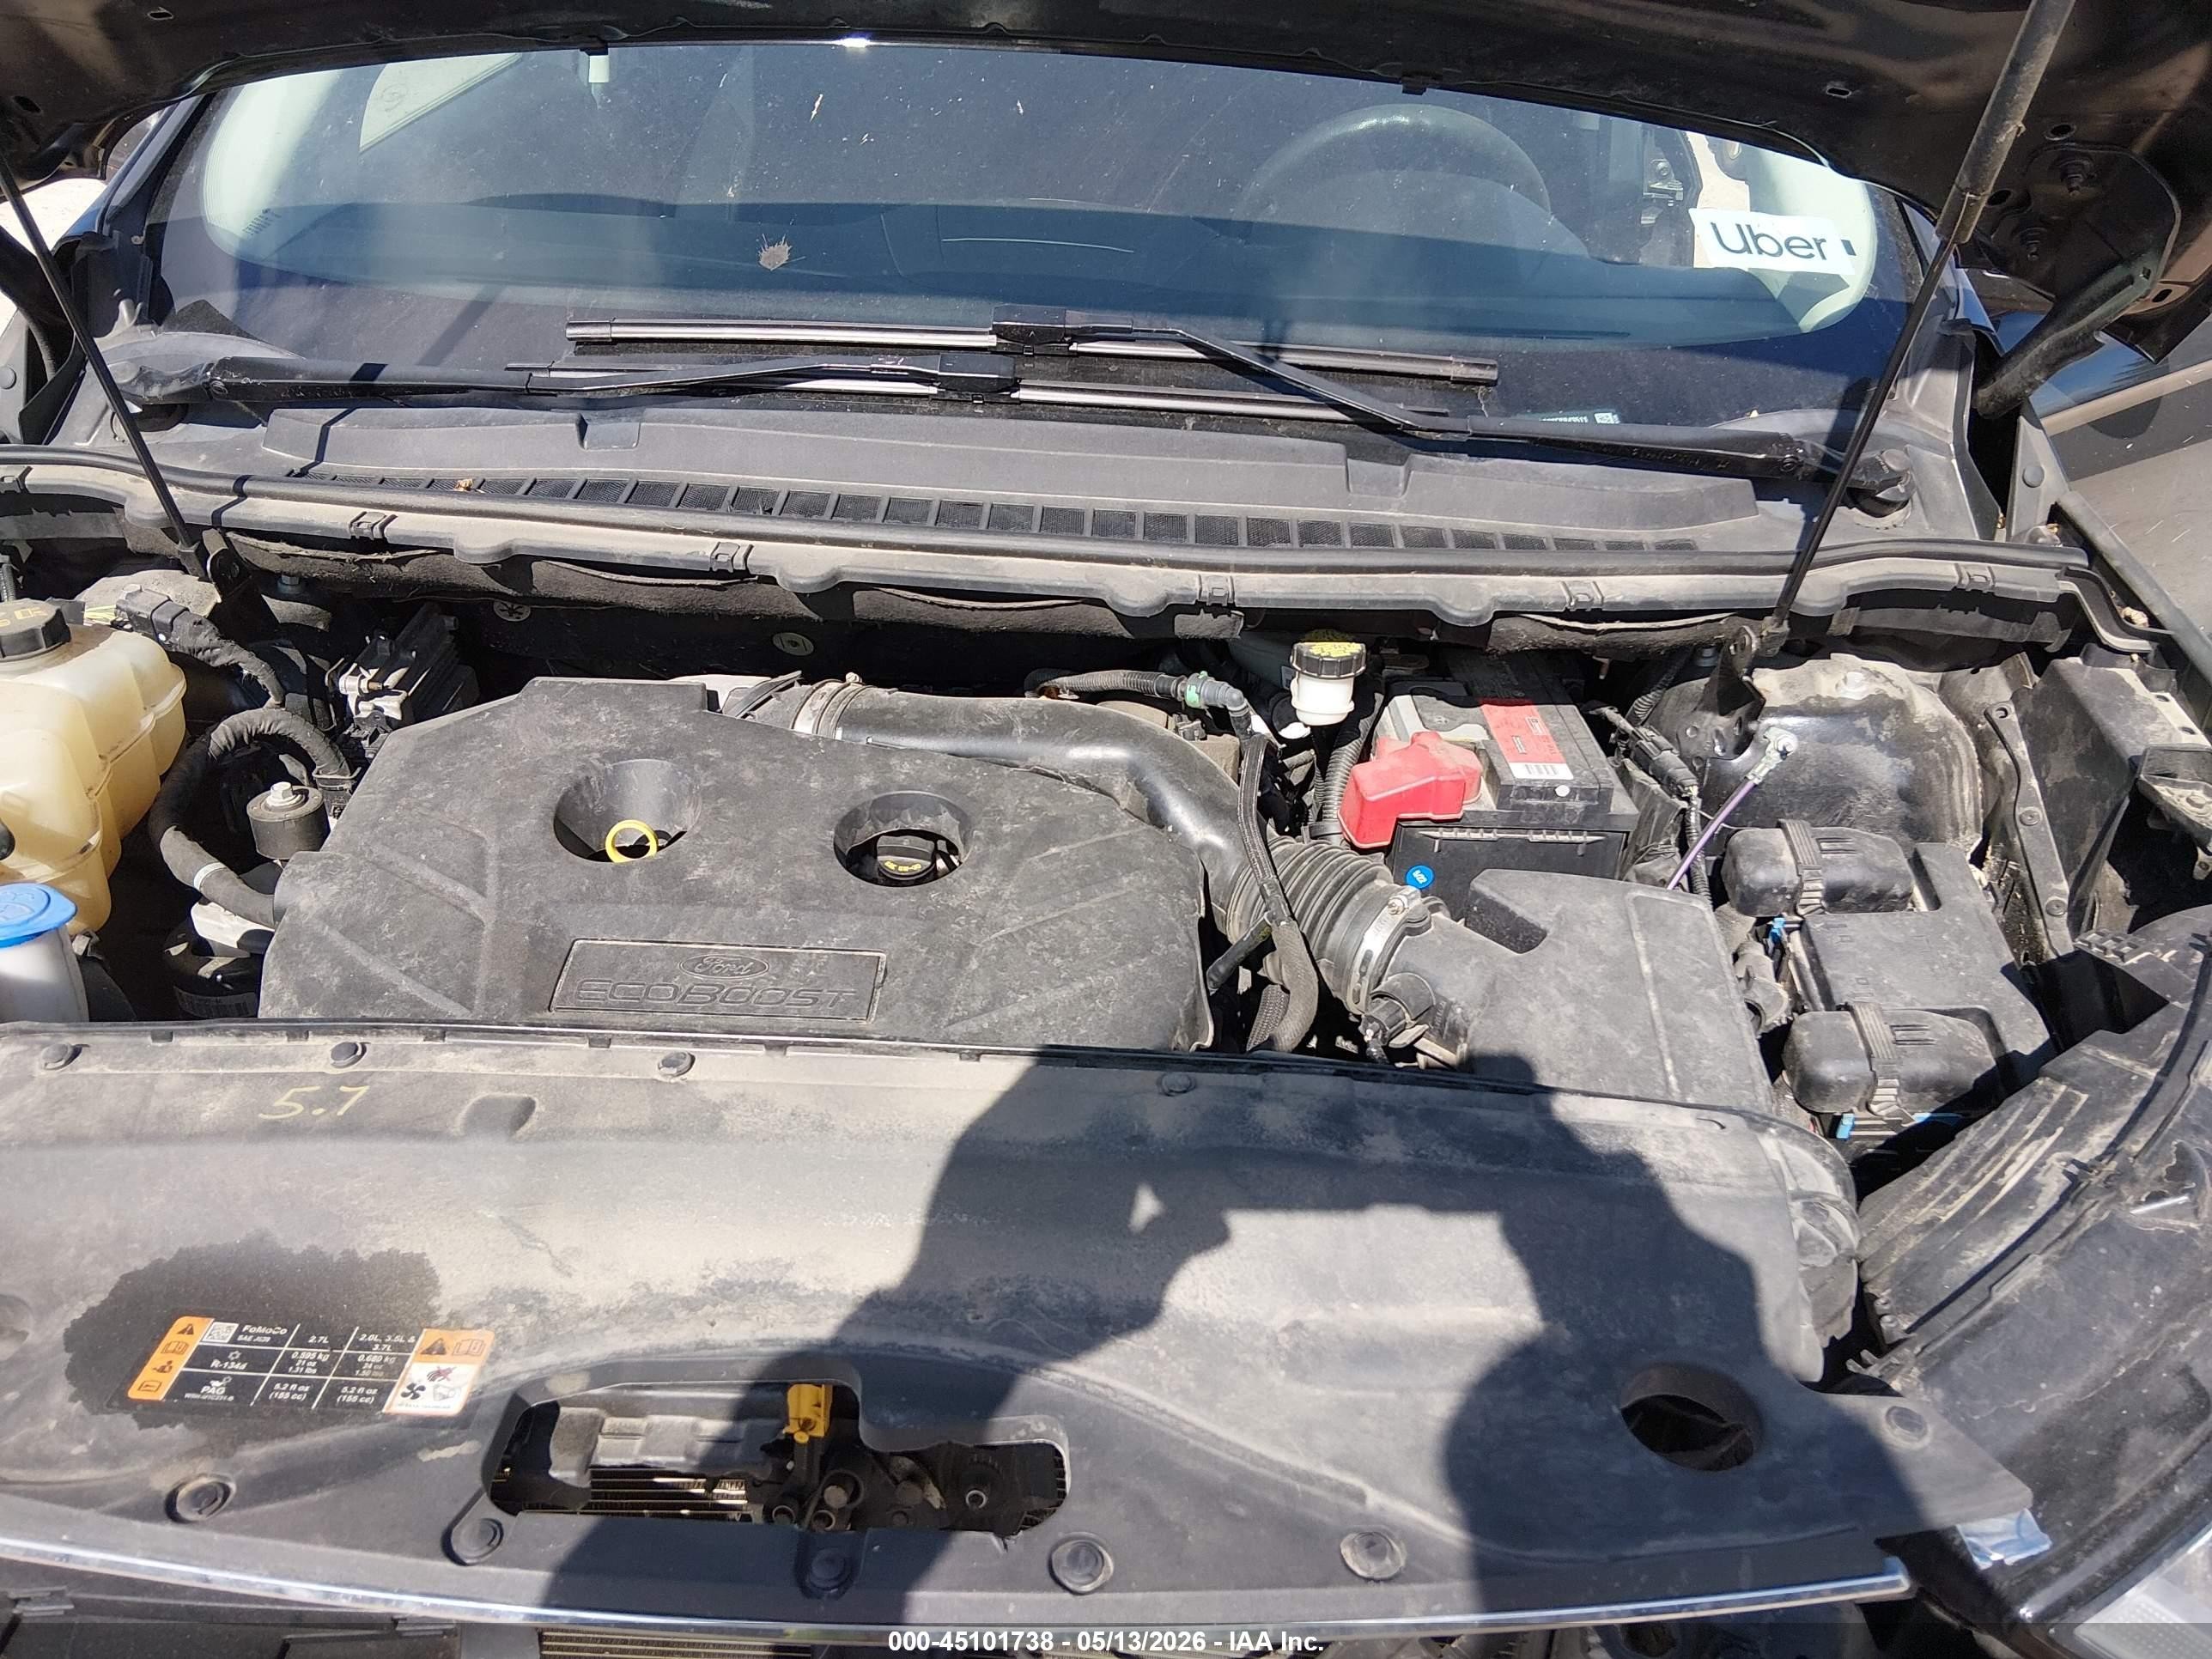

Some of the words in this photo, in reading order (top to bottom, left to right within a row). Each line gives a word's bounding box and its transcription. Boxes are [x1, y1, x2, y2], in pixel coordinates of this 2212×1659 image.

[1711, 222, 1827, 260] Uber
[693, 955, 752, 976] Ford
[576, 978, 857, 1008] ECOBOOST
[258, 1085, 370, 1120] 5.7
[241, 1324, 289, 1335] FoMoCo
[307, 1335, 329, 1344] 2.7L
[358, 1334, 382, 1343] 2.0L,
[317, 1353, 330, 1363] kg
[210, 1359, 247, 1370] R-134a
[201, 1386, 226, 1395] PAG
